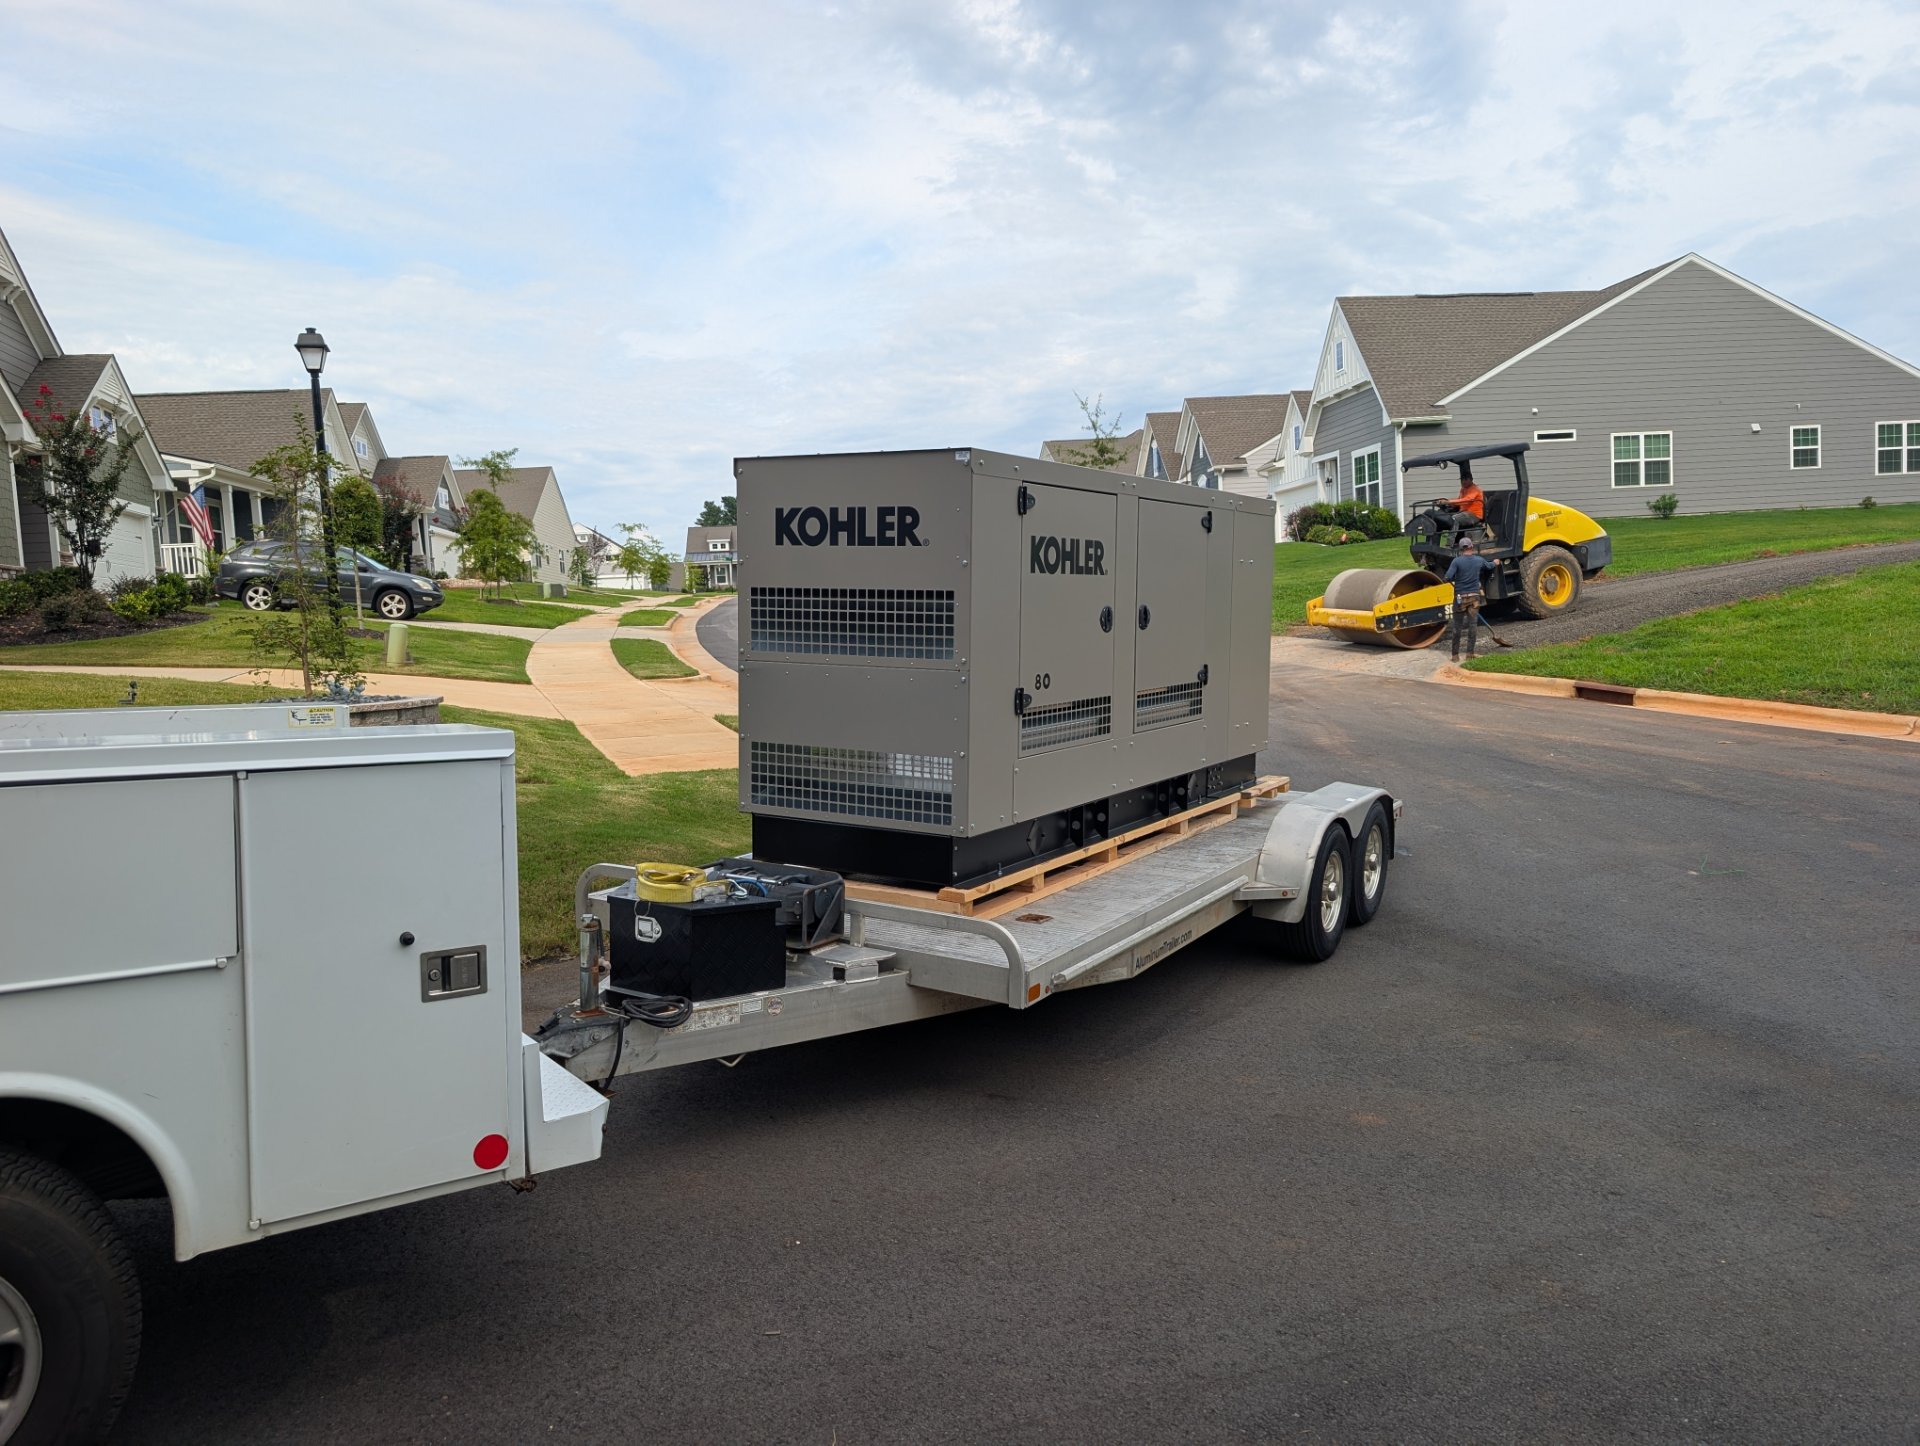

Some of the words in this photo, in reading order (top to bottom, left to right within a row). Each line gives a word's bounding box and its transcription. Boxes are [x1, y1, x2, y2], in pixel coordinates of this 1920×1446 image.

[775, 506, 922, 547] KOHLER
[1030, 535, 1105, 575] KOHLER
[1035, 672, 1051, 690] 80
